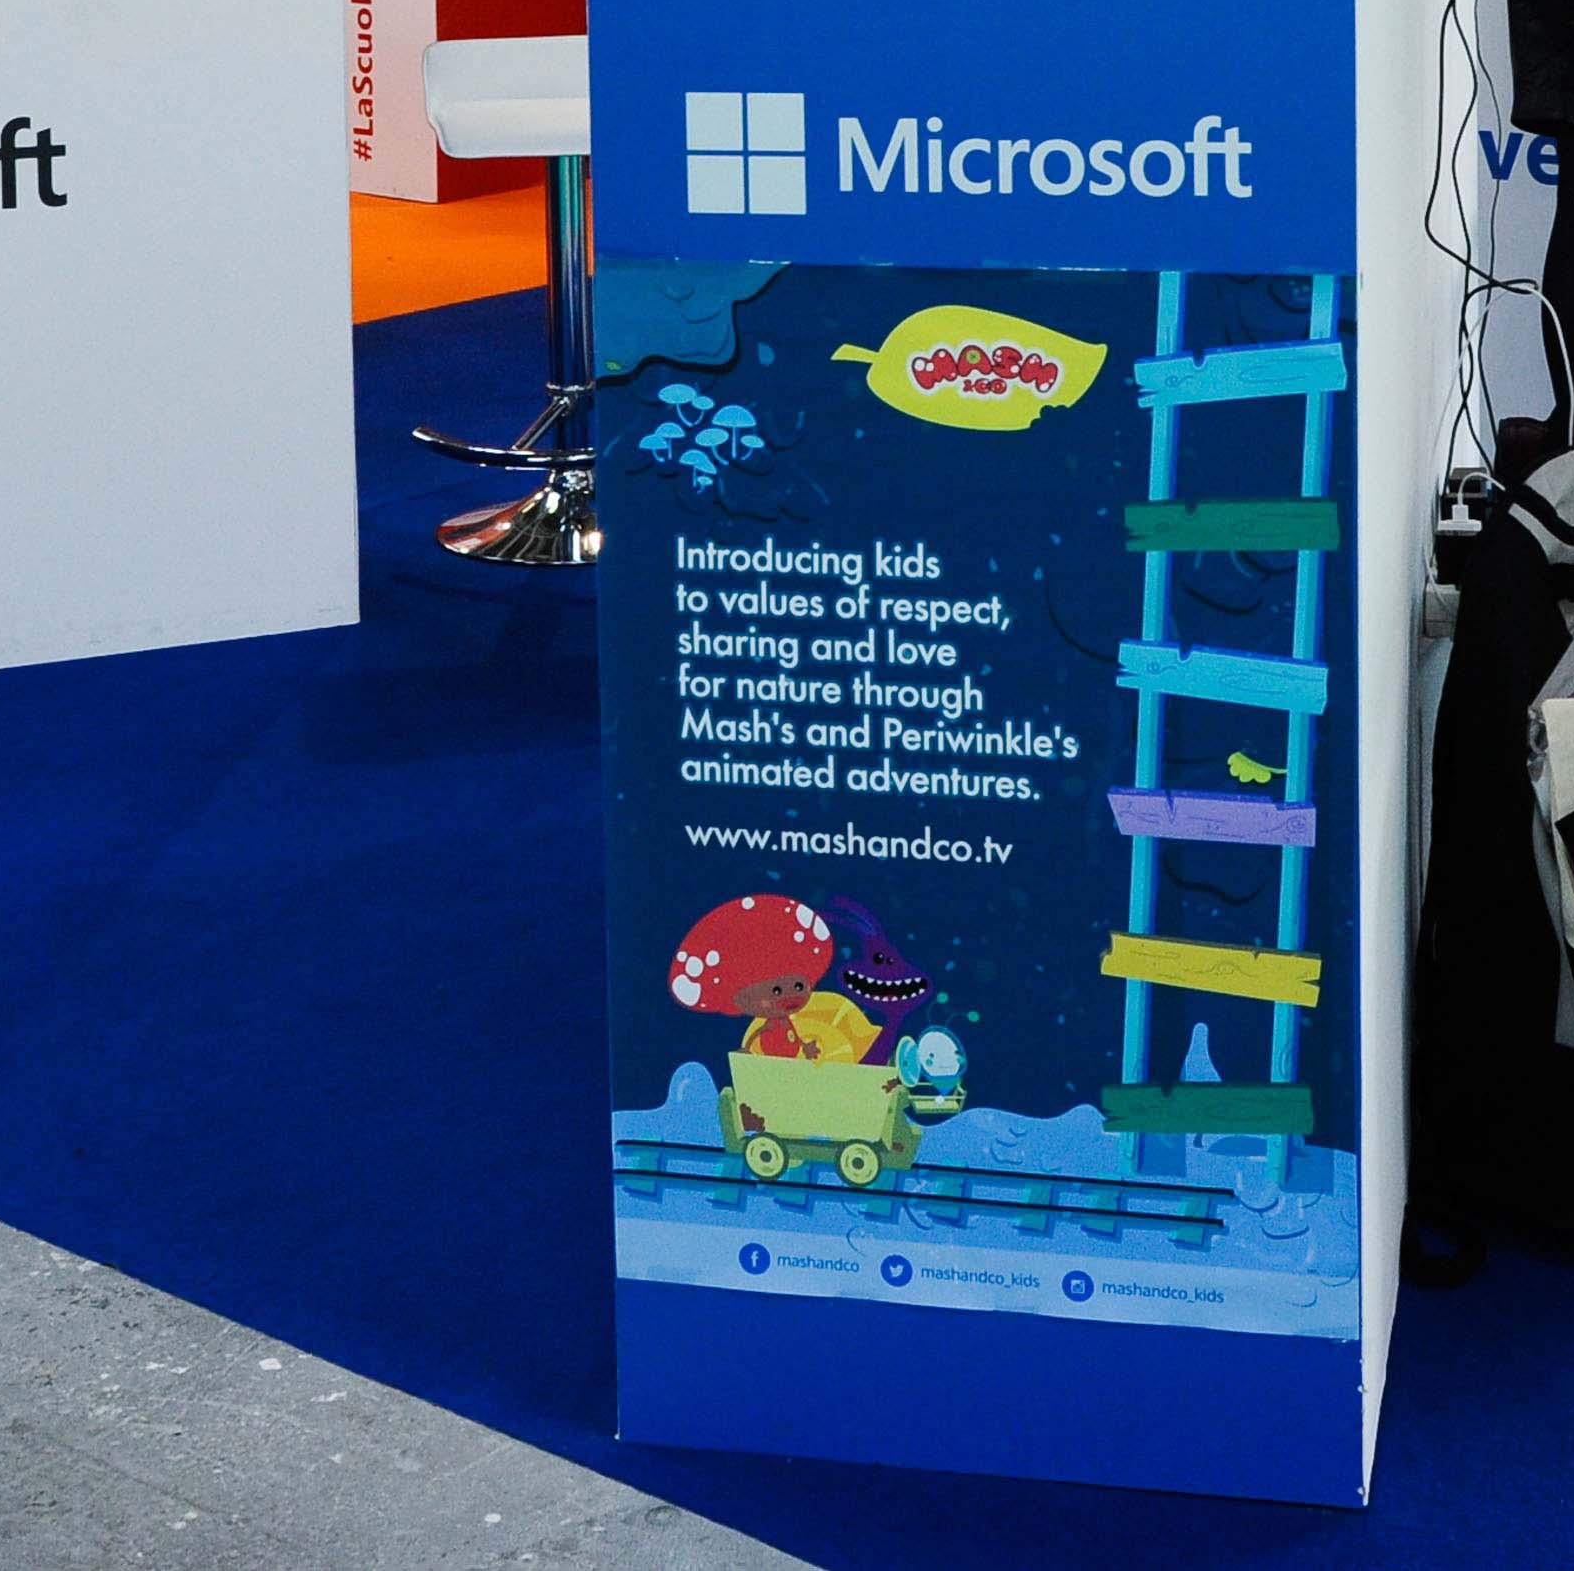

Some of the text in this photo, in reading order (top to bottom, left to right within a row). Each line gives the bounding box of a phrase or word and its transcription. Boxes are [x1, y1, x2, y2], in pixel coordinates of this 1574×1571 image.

[838, 115, 1253, 198] Microsoft
[678, 536, 941, 585] Introducing kids
[677, 580, 1011, 632] to values of respect,
[678, 621, 958, 668] sharing and love
[679, 663, 983, 719] for nature through
[681, 707, 1078, 759] Mash's and Periwinkle's
[681, 753, 1041, 801] animated adventures.
[685, 822, 1013, 864] www.mashandco.tv
[777, 1252, 860, 1274] mashandco
[921, 1264, 1040, 1289] mashandco_kids
[1102, 1279, 1225, 1304] mashandco_kids
